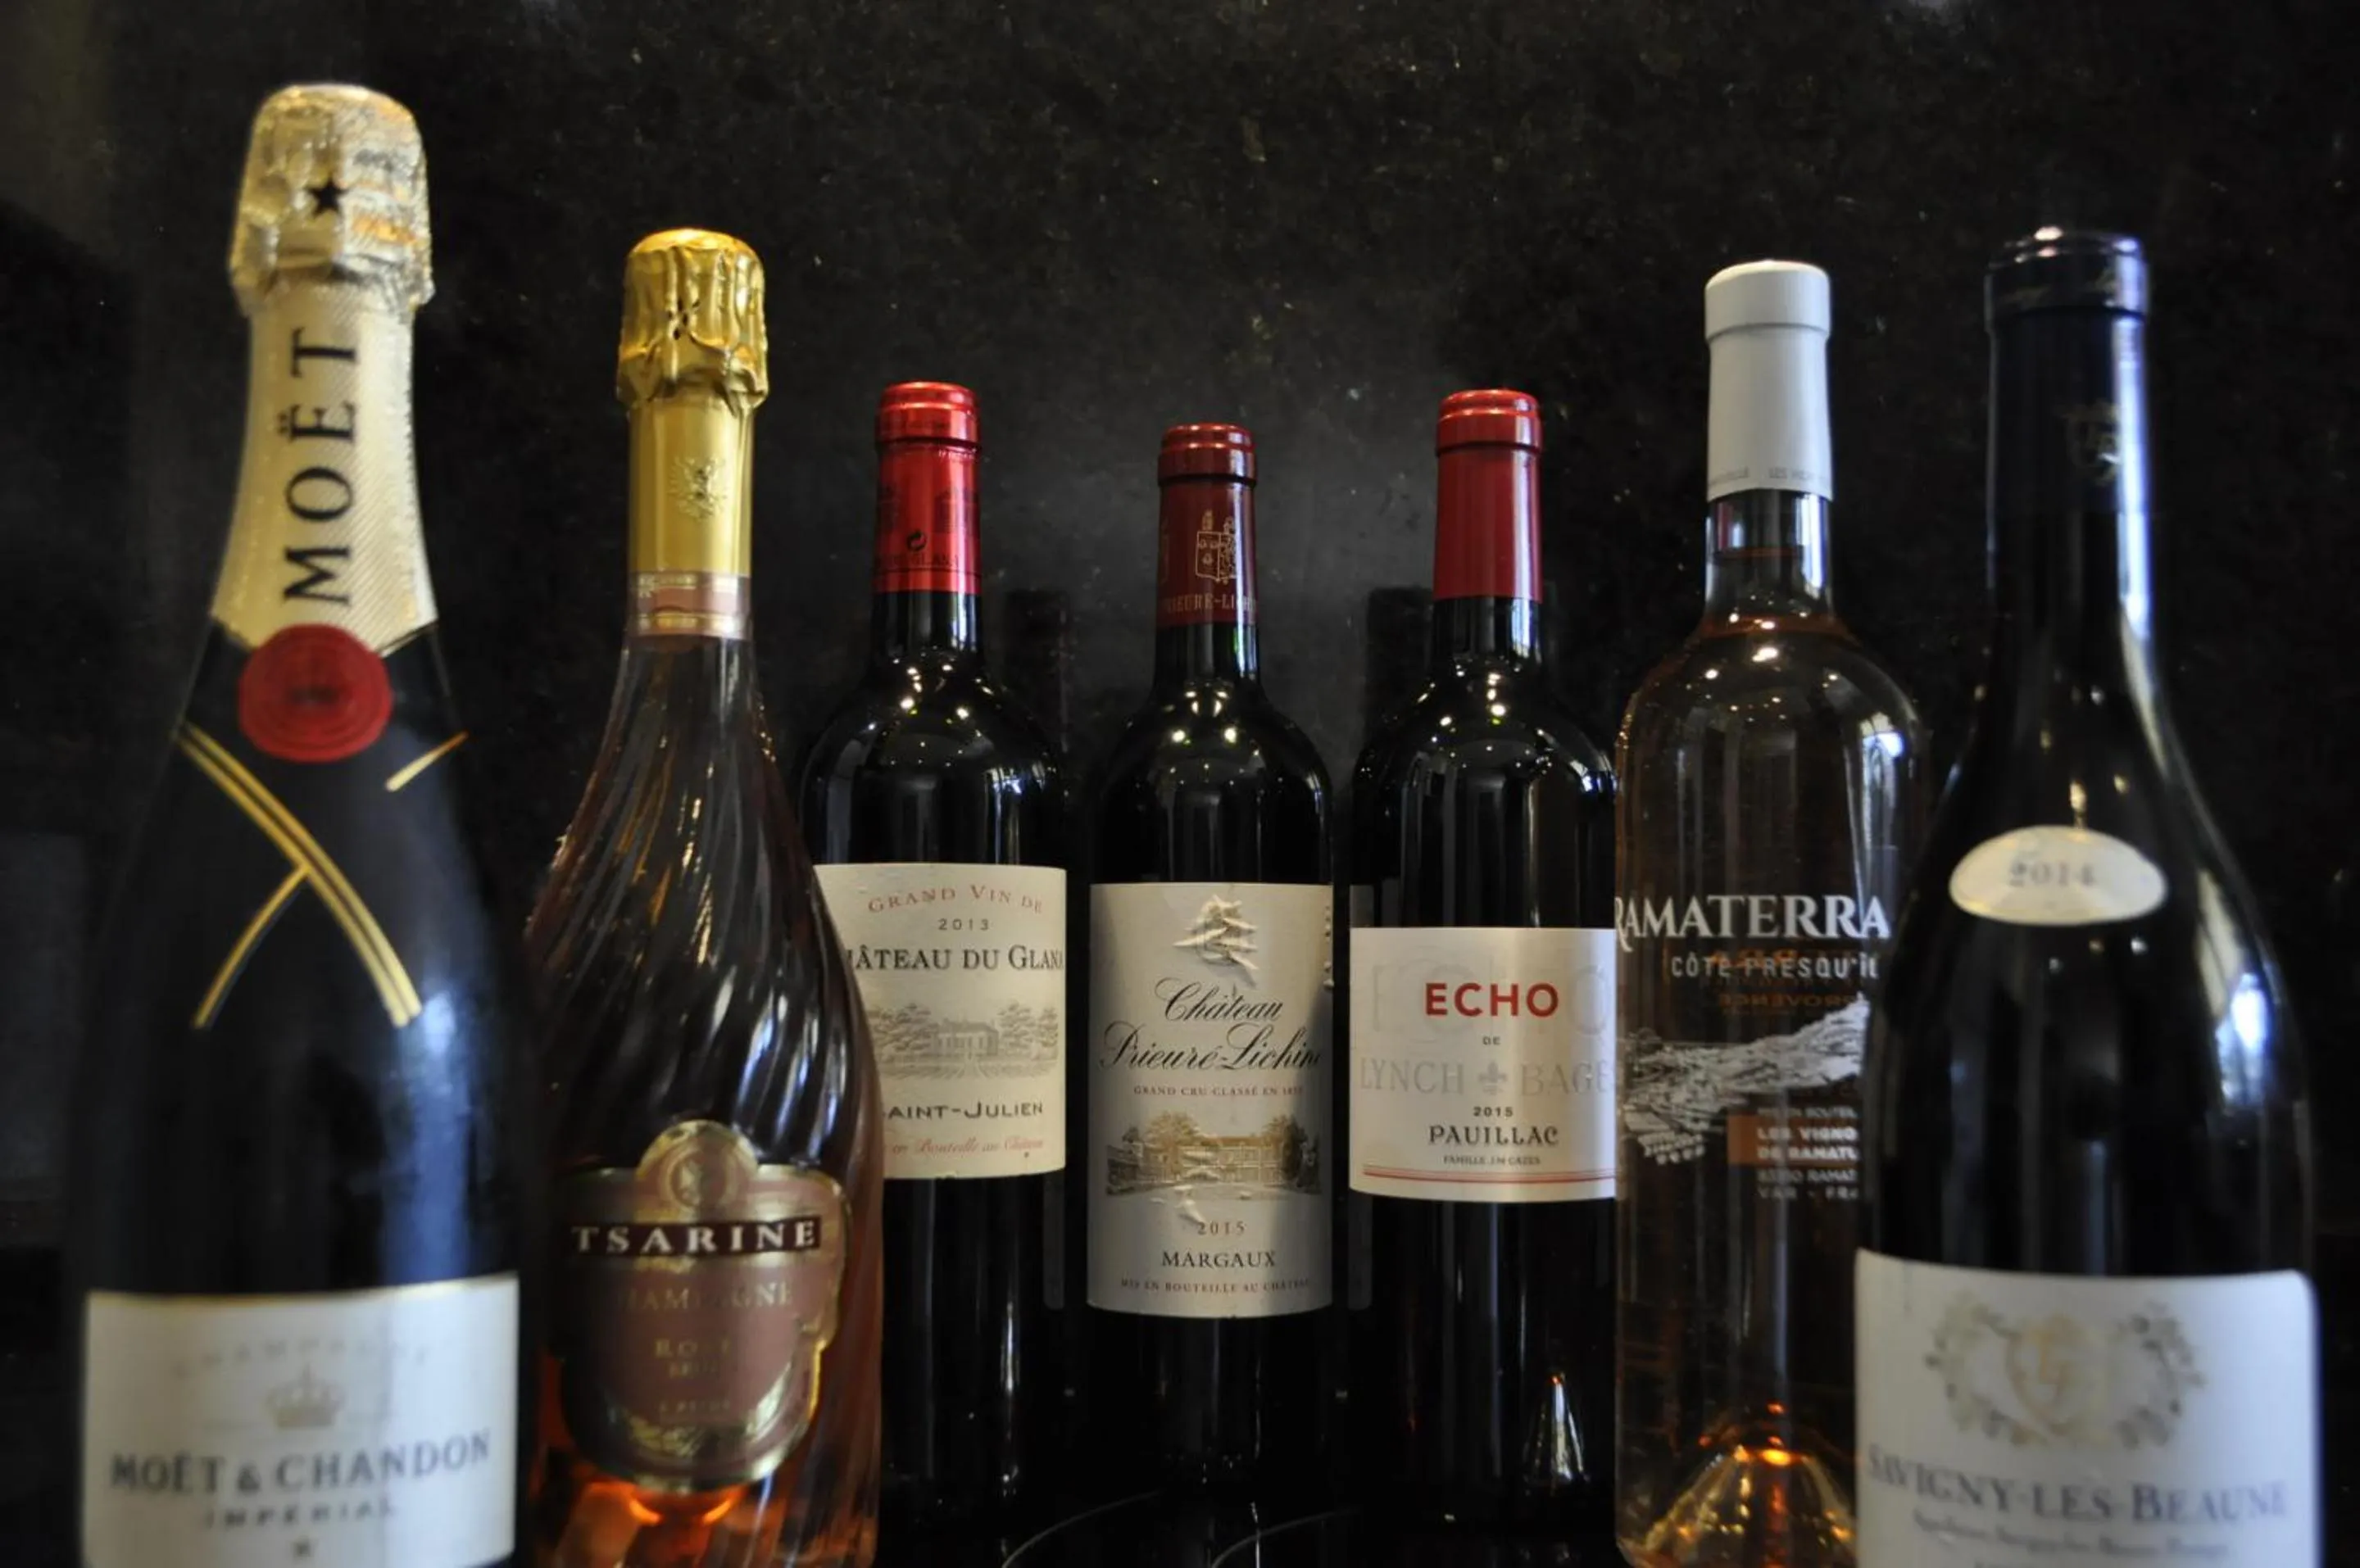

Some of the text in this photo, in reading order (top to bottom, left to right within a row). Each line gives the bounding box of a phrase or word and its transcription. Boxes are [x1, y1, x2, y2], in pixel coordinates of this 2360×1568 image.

[277, 327, 359, 608] MOËT
[2009, 861, 2096, 887] 2014
[868, 885, 1042, 913] GRAND VIN DE
[937, 918, 991, 931] 2013
[847, 944, 951, 970] ÂTEAU
[962, 949, 1001, 970] DU
[1155, 977, 1283, 1022] Château
[1425, 982, 1559, 1017] ECHO
[1359, 1057, 1464, 1094] LYNCH
[1134, 1085, 1176, 1096] GRAND
[1181, 1085, 1207, 1096] CRU
[883, 1101, 1043, 1120] AINT-JULIEN
[1473, 1106, 1514, 1117] 2015
[1429, 1125, 1559, 1145] PAUILLAC
[571, 1218, 816, 1253] TSARINE
[1197, 1221, 1246, 1235] 2015
[1162, 1250, 1277, 1269] MARGAUX
[1165, 1280, 1237, 1293] BOUTEILLE
[276, 1427, 492, 1489] CHANDON
